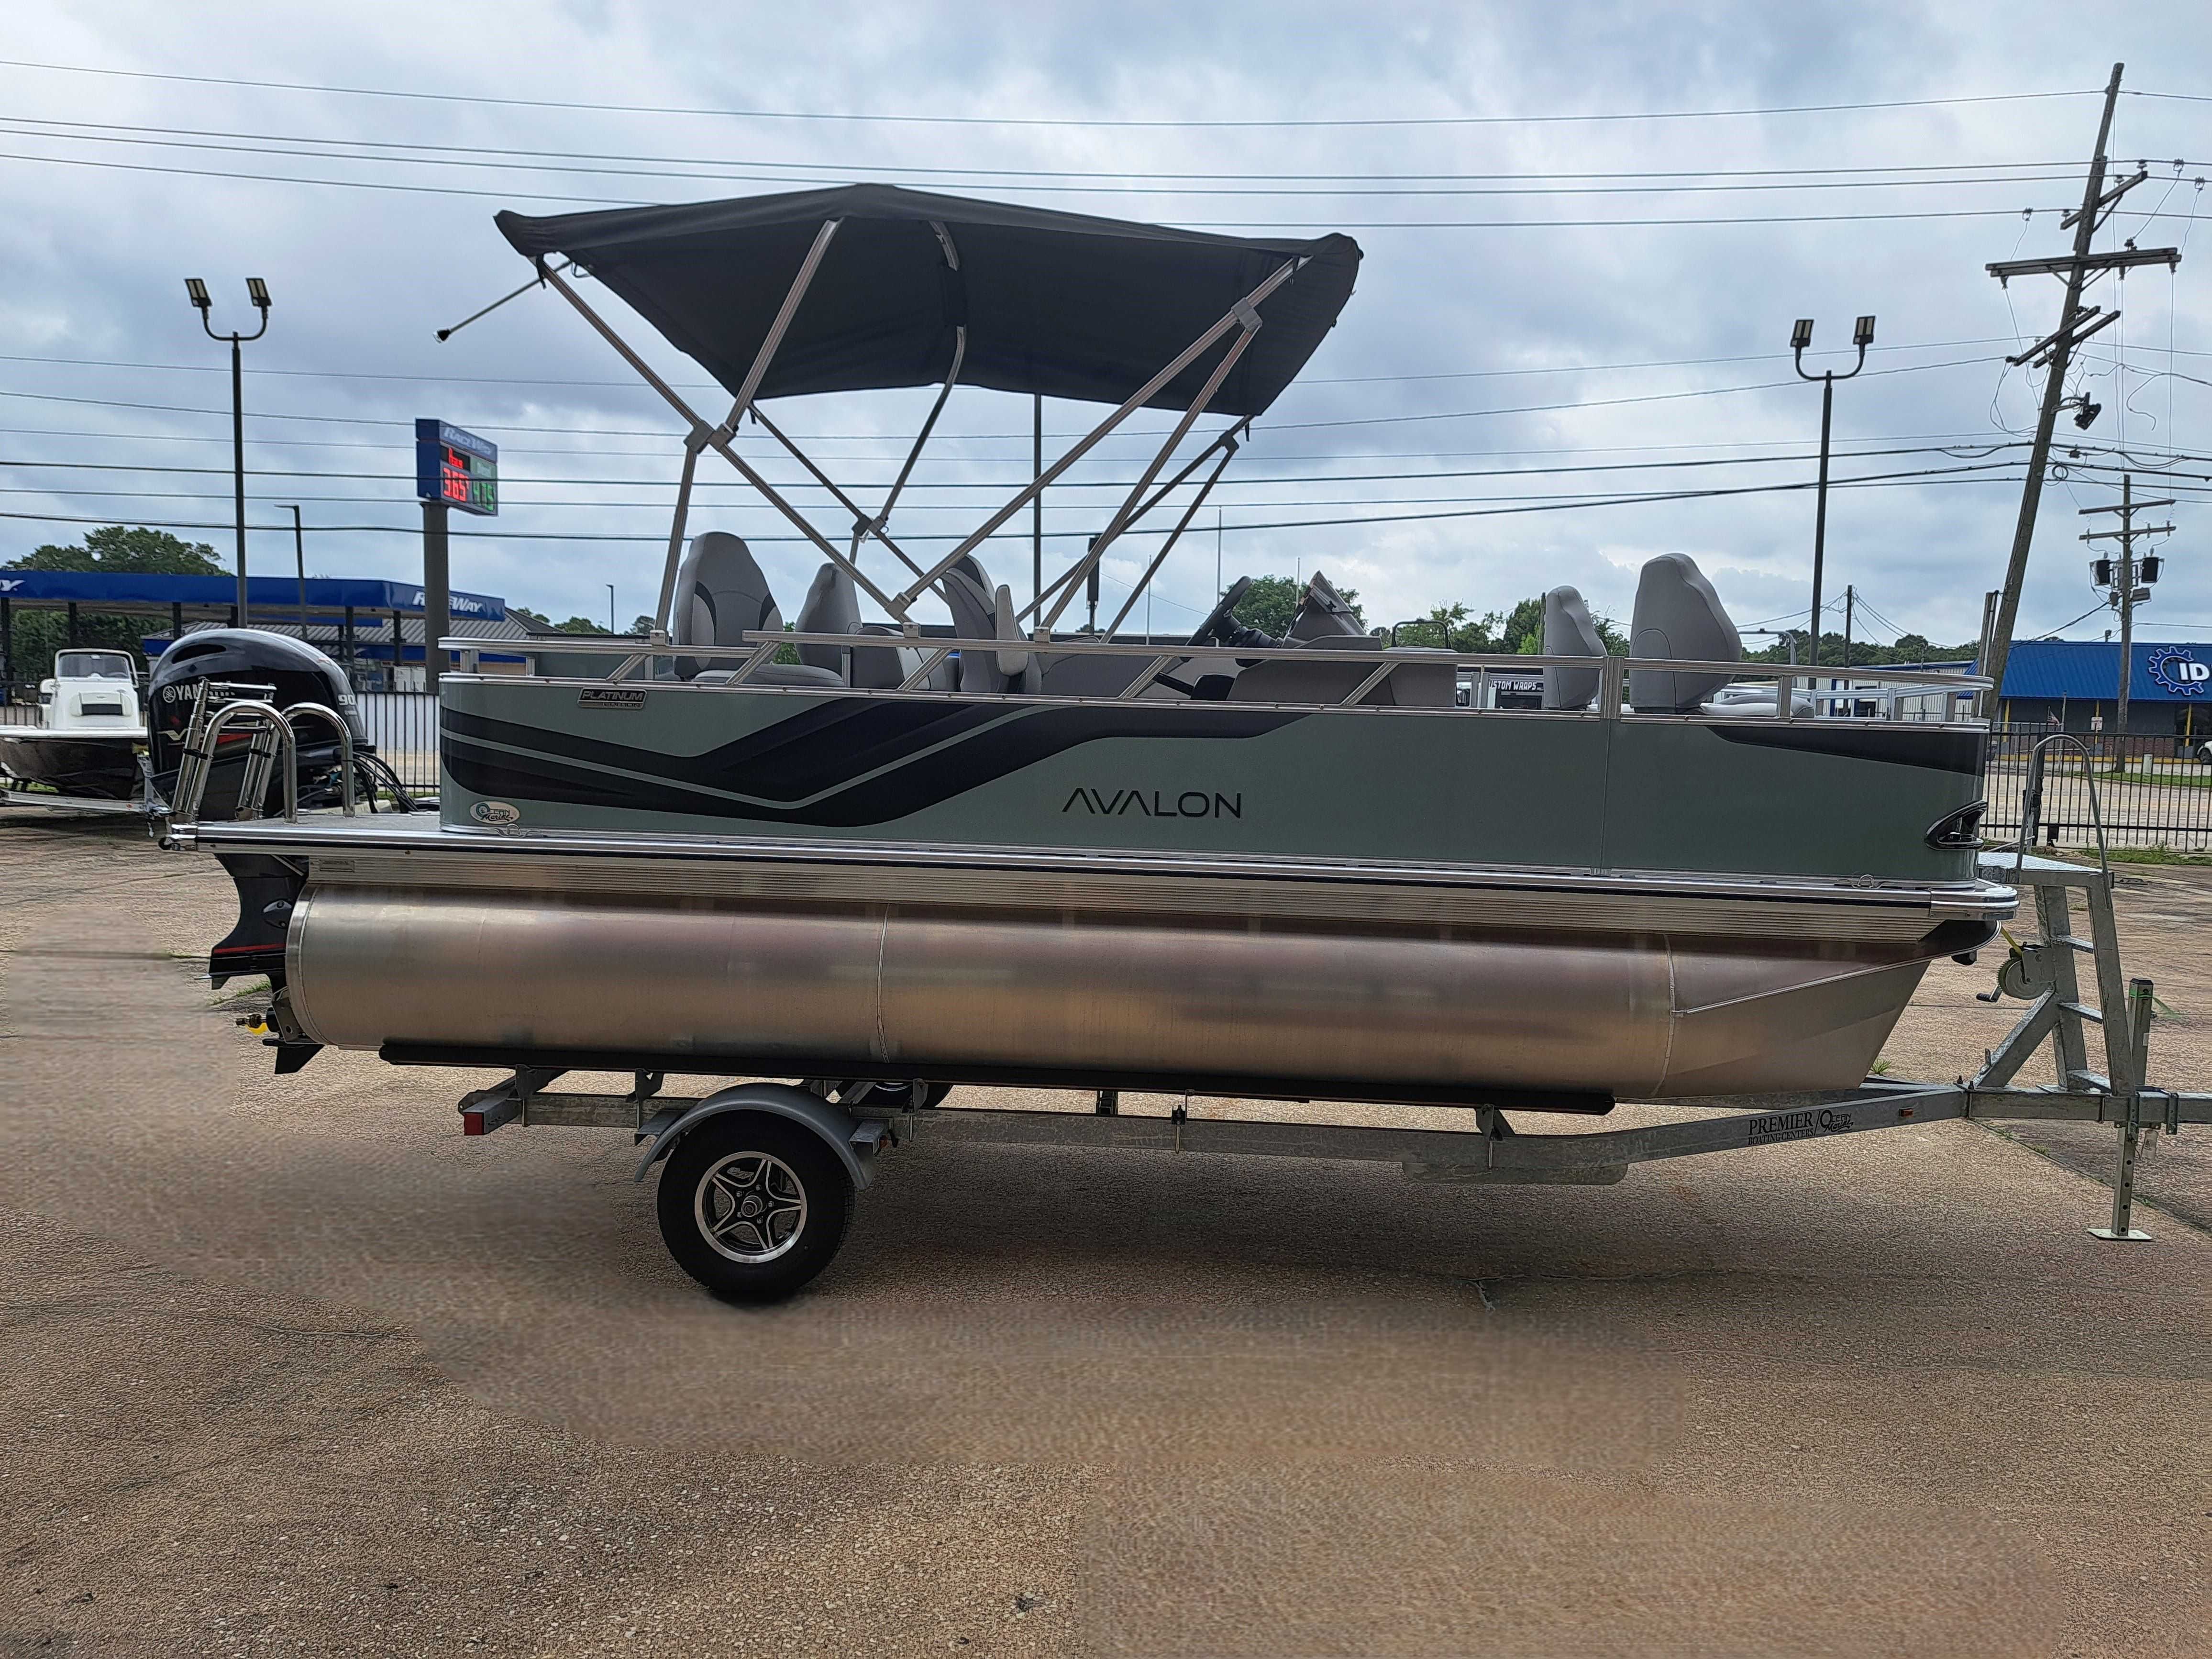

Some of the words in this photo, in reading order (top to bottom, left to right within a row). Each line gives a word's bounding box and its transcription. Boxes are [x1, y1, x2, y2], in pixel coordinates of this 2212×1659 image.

[1489, 680, 1511, 690] USTOM
[1513, 681, 1537, 691] WRAPS
[338, 695, 356, 706] 90
[582, 691, 644, 700] PLATINUM
[1062, 788, 1241, 818] AVALON
[1748, 1112, 1814, 1135] PREMIER
[1747, 1134, 1780, 1146] BOATING
[1782, 1128, 1814, 1141] CENTERS
